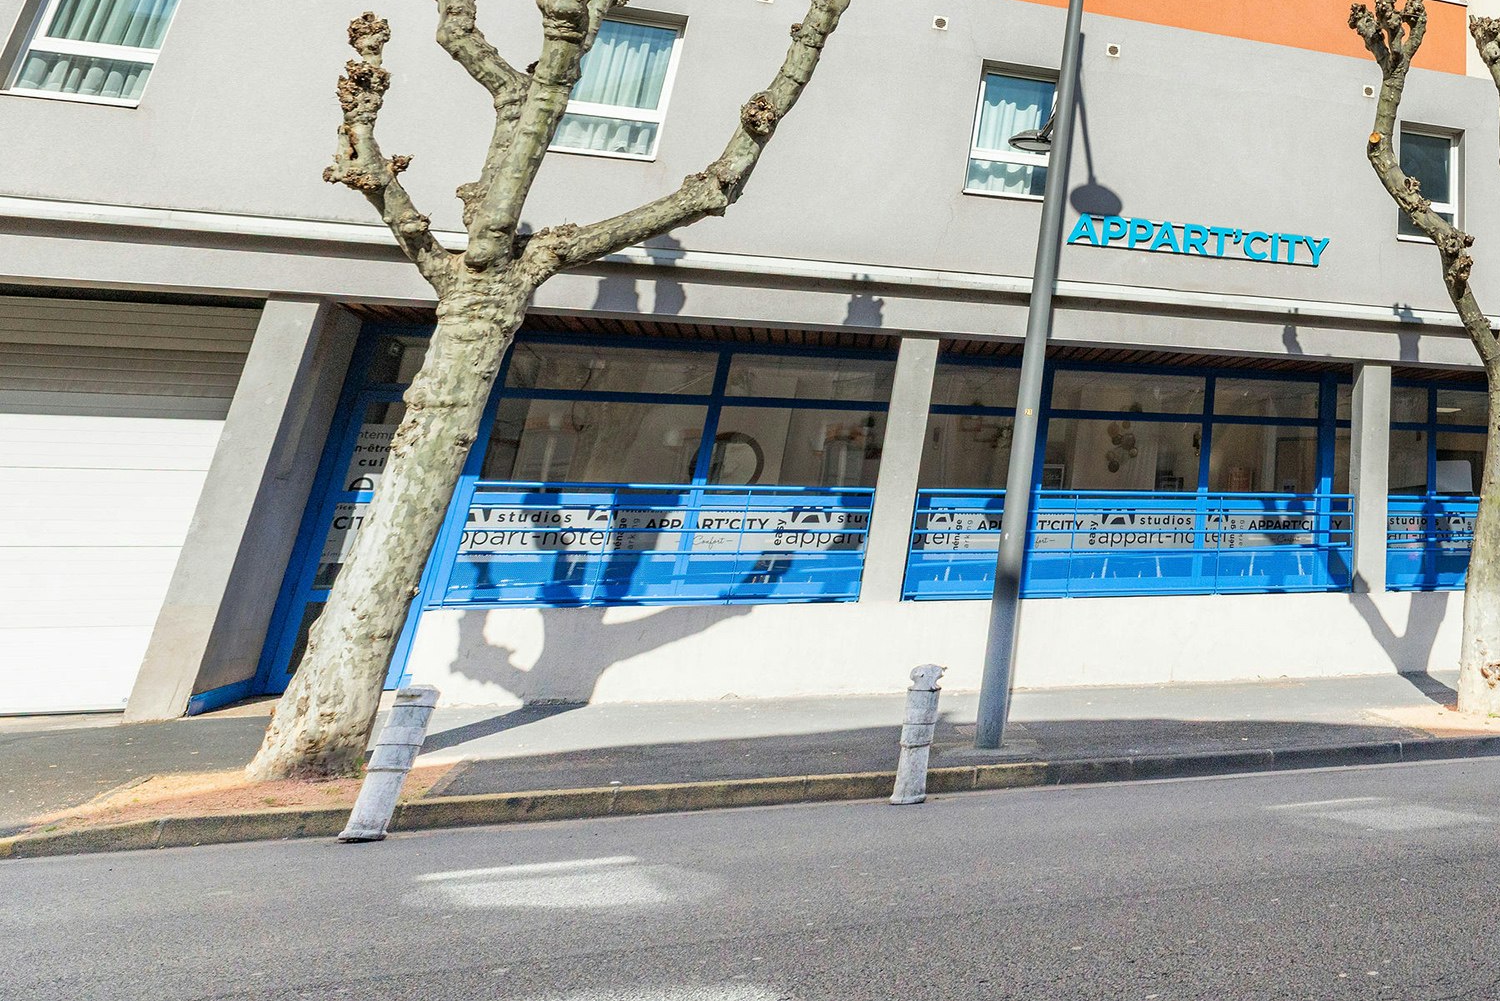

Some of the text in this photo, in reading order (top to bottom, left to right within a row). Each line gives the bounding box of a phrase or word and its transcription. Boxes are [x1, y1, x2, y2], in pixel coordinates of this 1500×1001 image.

[1067, 213, 1330, 267] APPART'CITY
[497, 511, 573, 523] studios
[1140, 515, 1192, 526] studios
[1248, 520, 1343, 531] APPART'CIY
